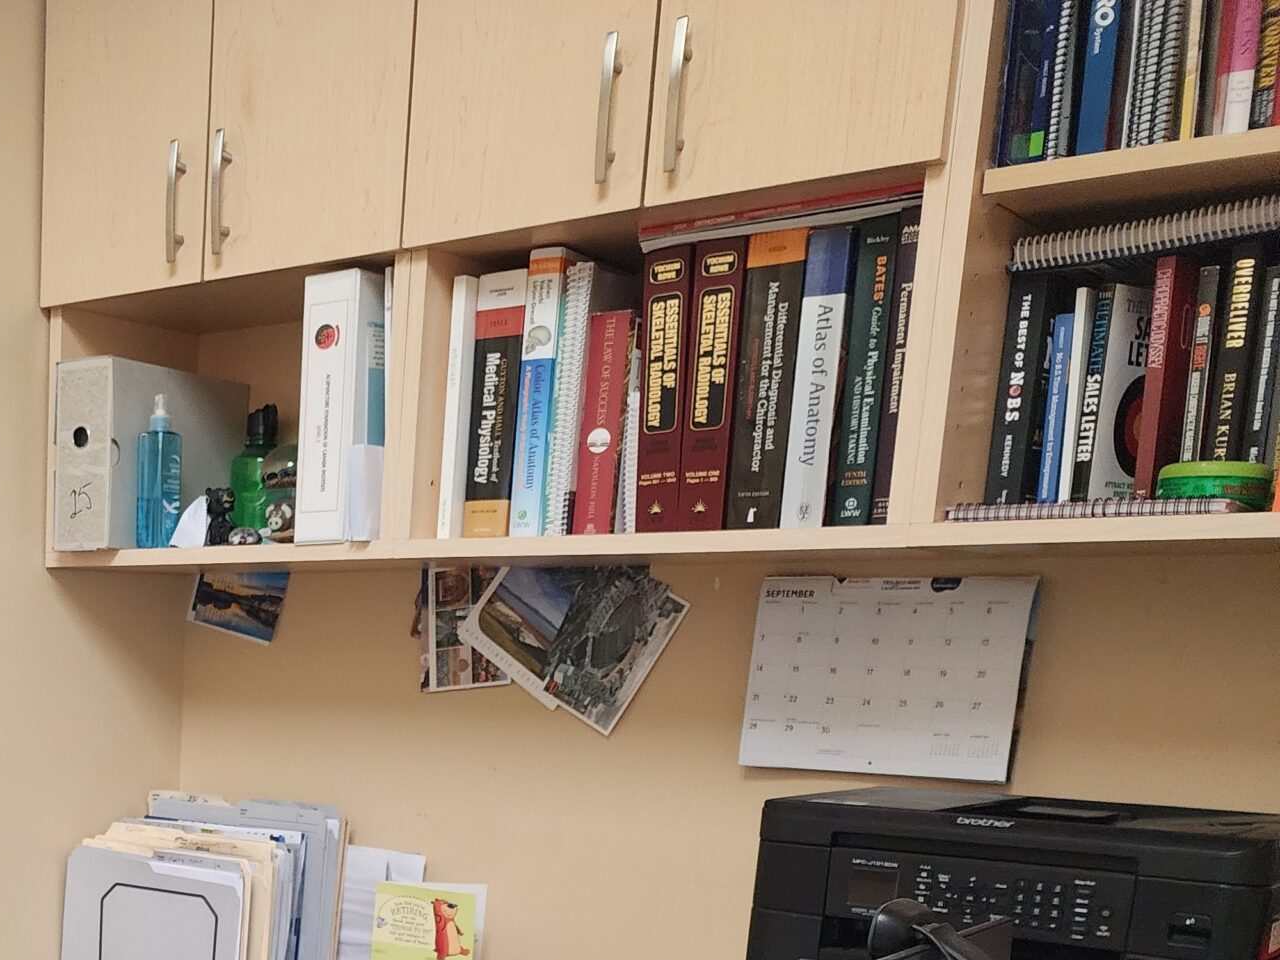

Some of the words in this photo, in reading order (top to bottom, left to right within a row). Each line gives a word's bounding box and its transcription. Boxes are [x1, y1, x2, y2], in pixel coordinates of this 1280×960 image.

[1091, 27, 1104, 53] System
[894, 282, 913, 344] Permanent
[1020, 294, 1031, 317] THE
[1151, 269, 1173, 328] CHIROPRACTIC
[1225, 258, 1255, 347] OVERDELIVER
[489, 319, 509, 328] HALL
[604, 318, 616, 339] THE
[650, 301, 665, 360] SKELETAL
[662, 298, 680, 370] ESSENTIALS
[699, 294, 716, 354] SKELETAL
[712, 292, 731, 365] ESSENTIALS
[760, 281, 779, 358] Management
[772, 302, 788, 367] Differential
[813, 304, 834, 350] Atlas
[869, 306, 882, 335] Guide
[1015, 320, 1029, 350] BEST
[1088, 299, 1110, 373] ULTIMATE
[1196, 316, 1210, 336] DOING
[602, 341, 614, 363] LAW
[867, 338, 878, 348] to
[1013, 351, 1025, 367] OF
[1147, 328, 1166, 368] ODYSSEY
[482, 352, 501, 406] Medical
[498, 358, 507, 393] GUYTON
[532, 365, 545, 393] Color
[601, 365, 611, 379] OF
[661, 372, 675, 388] OF
[710, 368, 725, 384] OF
[760, 359, 771, 376] for
[810, 357, 829, 376] of
[853, 375, 863, 393] AND
[861, 350, 879, 395] Physical
[886, 348, 906, 414] Impairment
[496, 397, 504, 412] AND
[596, 382, 610, 424] SUCCESS
[647, 362, 662, 427] RADIOLOGY
[694, 357, 711, 423] RADIOLOGY
[758, 378, 770, 397] the
[765, 369, 781, 426] Diagnosis
[1082, 374, 1101, 413] SALES
[1219, 373, 1236, 419] BRIAN
[494, 415, 503, 436] HALL
[529, 398, 542, 427] Atlas
[797, 382, 826, 466] Anatomy
[849, 395, 861, 431] HISTORY
[855, 397, 874, 463] Examination
[472, 410, 496, 483] Physiology
[528, 430, 539, 439] of
[749, 399, 768, 471] Chiropractor
[764, 427, 776, 450] and
[846, 432, 857, 464] TAKING
[1076, 415, 1096, 461] LETTER
[491, 439, 501, 471] Textbook
[523, 443, 538, 490] Anatomy
[1000, 434, 1012, 477] KENNEDY
[489, 473, 499, 481] of
[589, 455, 600, 499] NAPOLEON
[640, 472, 662, 480] VOLUME
[70, 482, 93, 519] 25
[840, 508, 861, 518] LWW
[766, 590, 815, 598] SEPTEMBER
[956, 816, 1015, 828] brother
